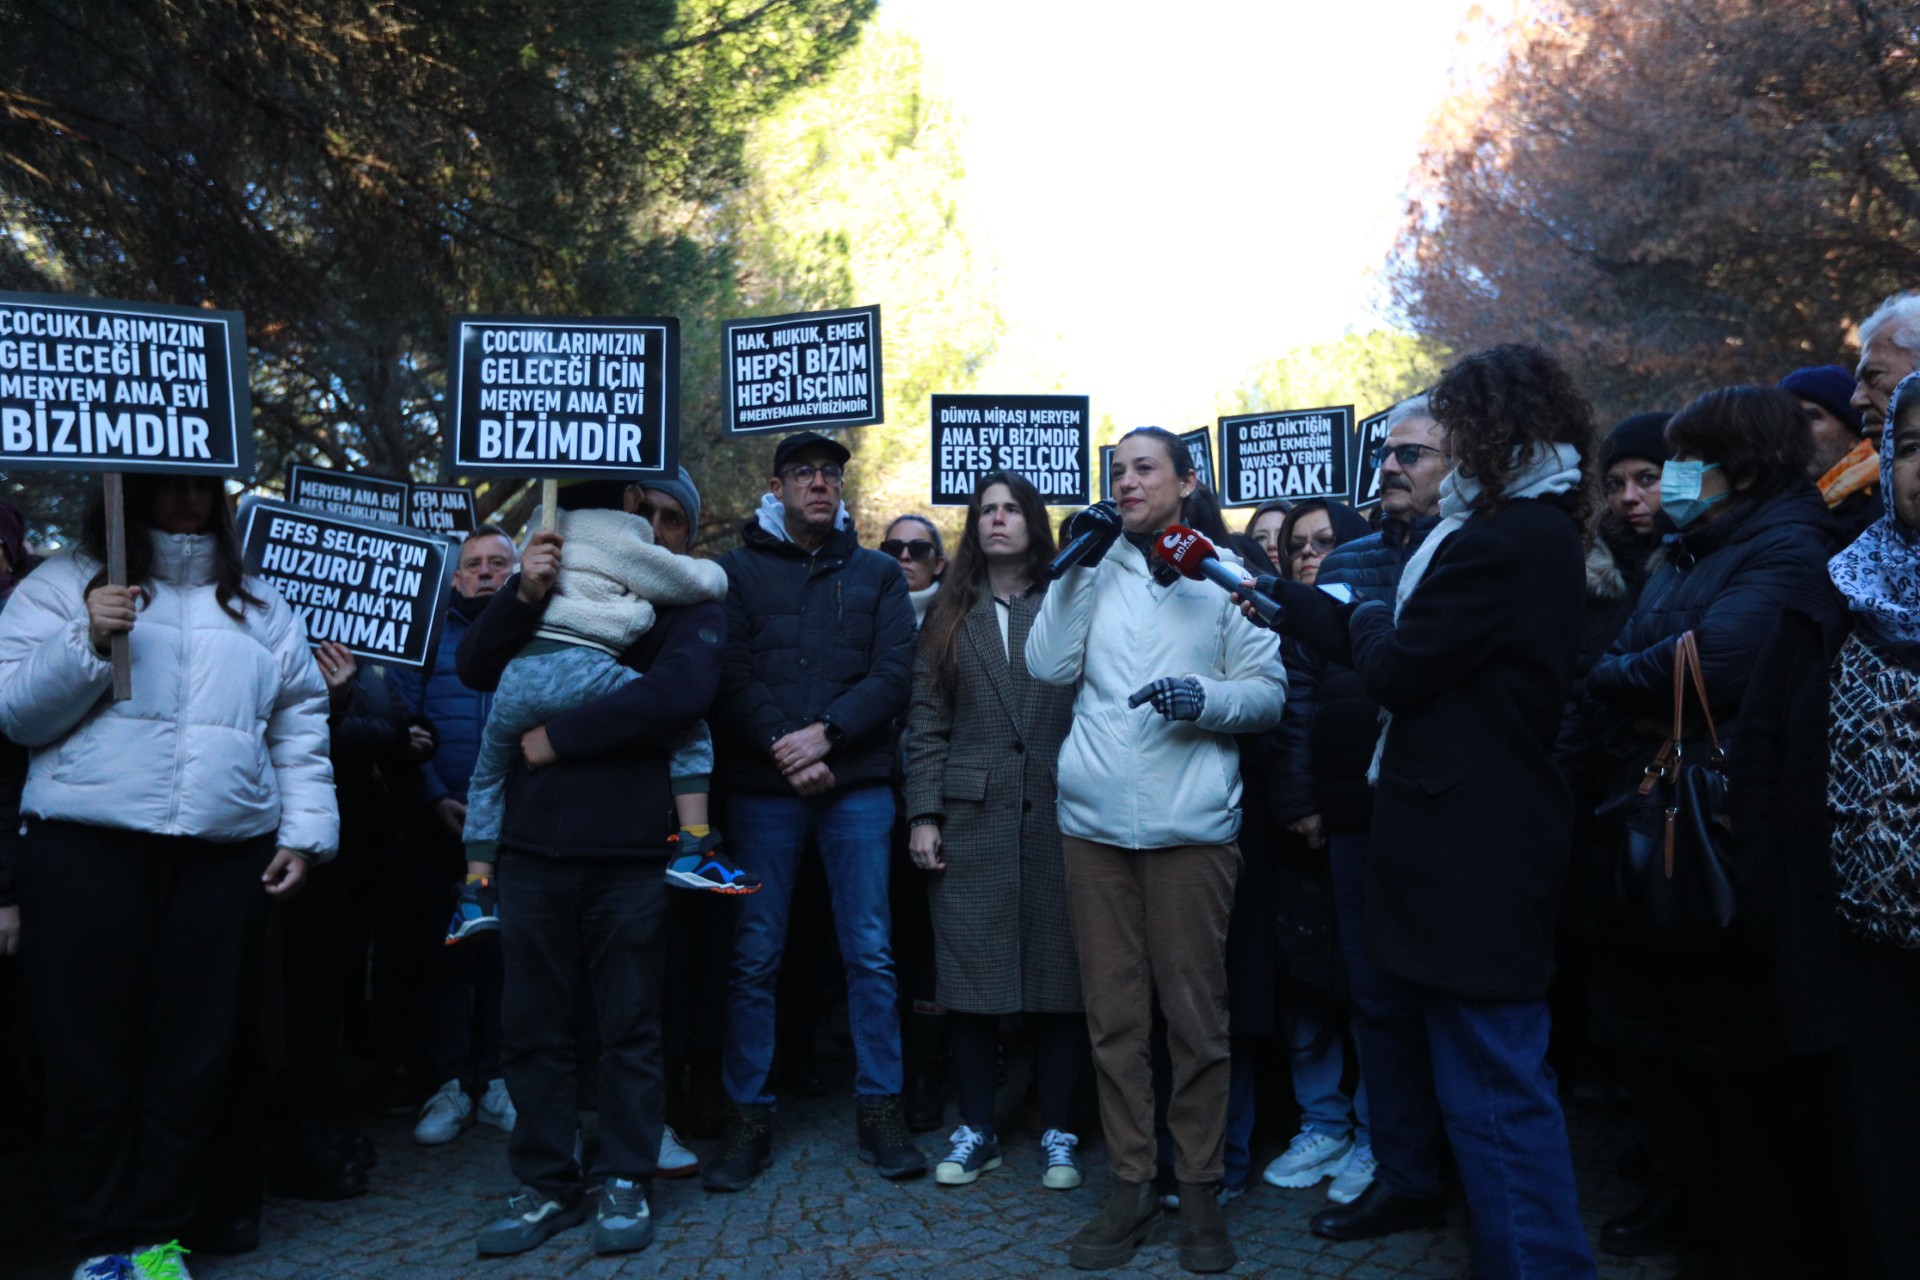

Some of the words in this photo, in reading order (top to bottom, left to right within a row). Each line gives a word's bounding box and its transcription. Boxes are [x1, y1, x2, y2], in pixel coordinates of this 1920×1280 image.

[0, 310, 205, 348] ÇOCUKLARIMIZIN
[483, 330, 645, 355] ÇOCUKLARIMIZIN
[737, 332, 770, 351] HAK,
[773, 326, 823, 347] HUKUK,
[827, 321, 866, 342] EMEK
[0, 341, 141, 376] GELECEĞİ
[150, 345, 207, 381] İÇİN
[481, 355, 591, 386] GELECEĞİ
[599, 356, 645, 390] İÇİN
[737, 346, 799, 382] HEPSİ
[806, 341, 866, 374] BİZİM
[1, 374, 107, 403] MERYEM
[114, 380, 166, 405] ANA
[172, 380, 209, 409] EVİ
[481, 389, 561, 412] MERYEM
[567, 391, 608, 414] ANA
[614, 389, 644, 415] EVİ
[737, 376, 791, 407] HEPSİ
[796, 370, 868, 402] İŞÇİNİN
[739, 397, 868, 423] #MERYEMANAEVİBİZİMDİR
[940, 406, 981, 423] DÜNYA
[984, 406, 1026, 424] MİRASI
[1030, 410, 1080, 424] MERYEM
[2, 401, 212, 459] BİZİMDİR
[479, 411, 642, 463] BİZİMDİR
[941, 427, 975, 445] ANA
[979, 423, 1004, 446] EVİ
[1009, 423, 1080, 446] BİZİMDİR
[1239, 426, 1247, 440] O
[1250, 421, 1274, 439] GÖZ
[1276, 415, 1331, 436] DİKTİĞİN
[1239, 438, 1278, 455] HALKIN
[1280, 431, 1331, 451] EKMEĞİNİ
[941, 446, 992, 470] EFES
[998, 446, 1080, 472] SELÇUK
[1291, 448, 1332, 464] YERİNE
[300, 480, 352, 502] MERYEM
[354, 488, 379, 507] ANA
[381, 492, 400, 510] EVİ
[1240, 463, 1332, 500] BIRAK!
[442, 492, 467, 510] ANA
[269, 517, 319, 546] EFES
[321, 528, 427, 567] SELÇUK'UN
[261, 543, 366, 586] HUZURU
[370, 558, 422, 597] İÇİN
[344, 591, 413, 623] ANA'YA
